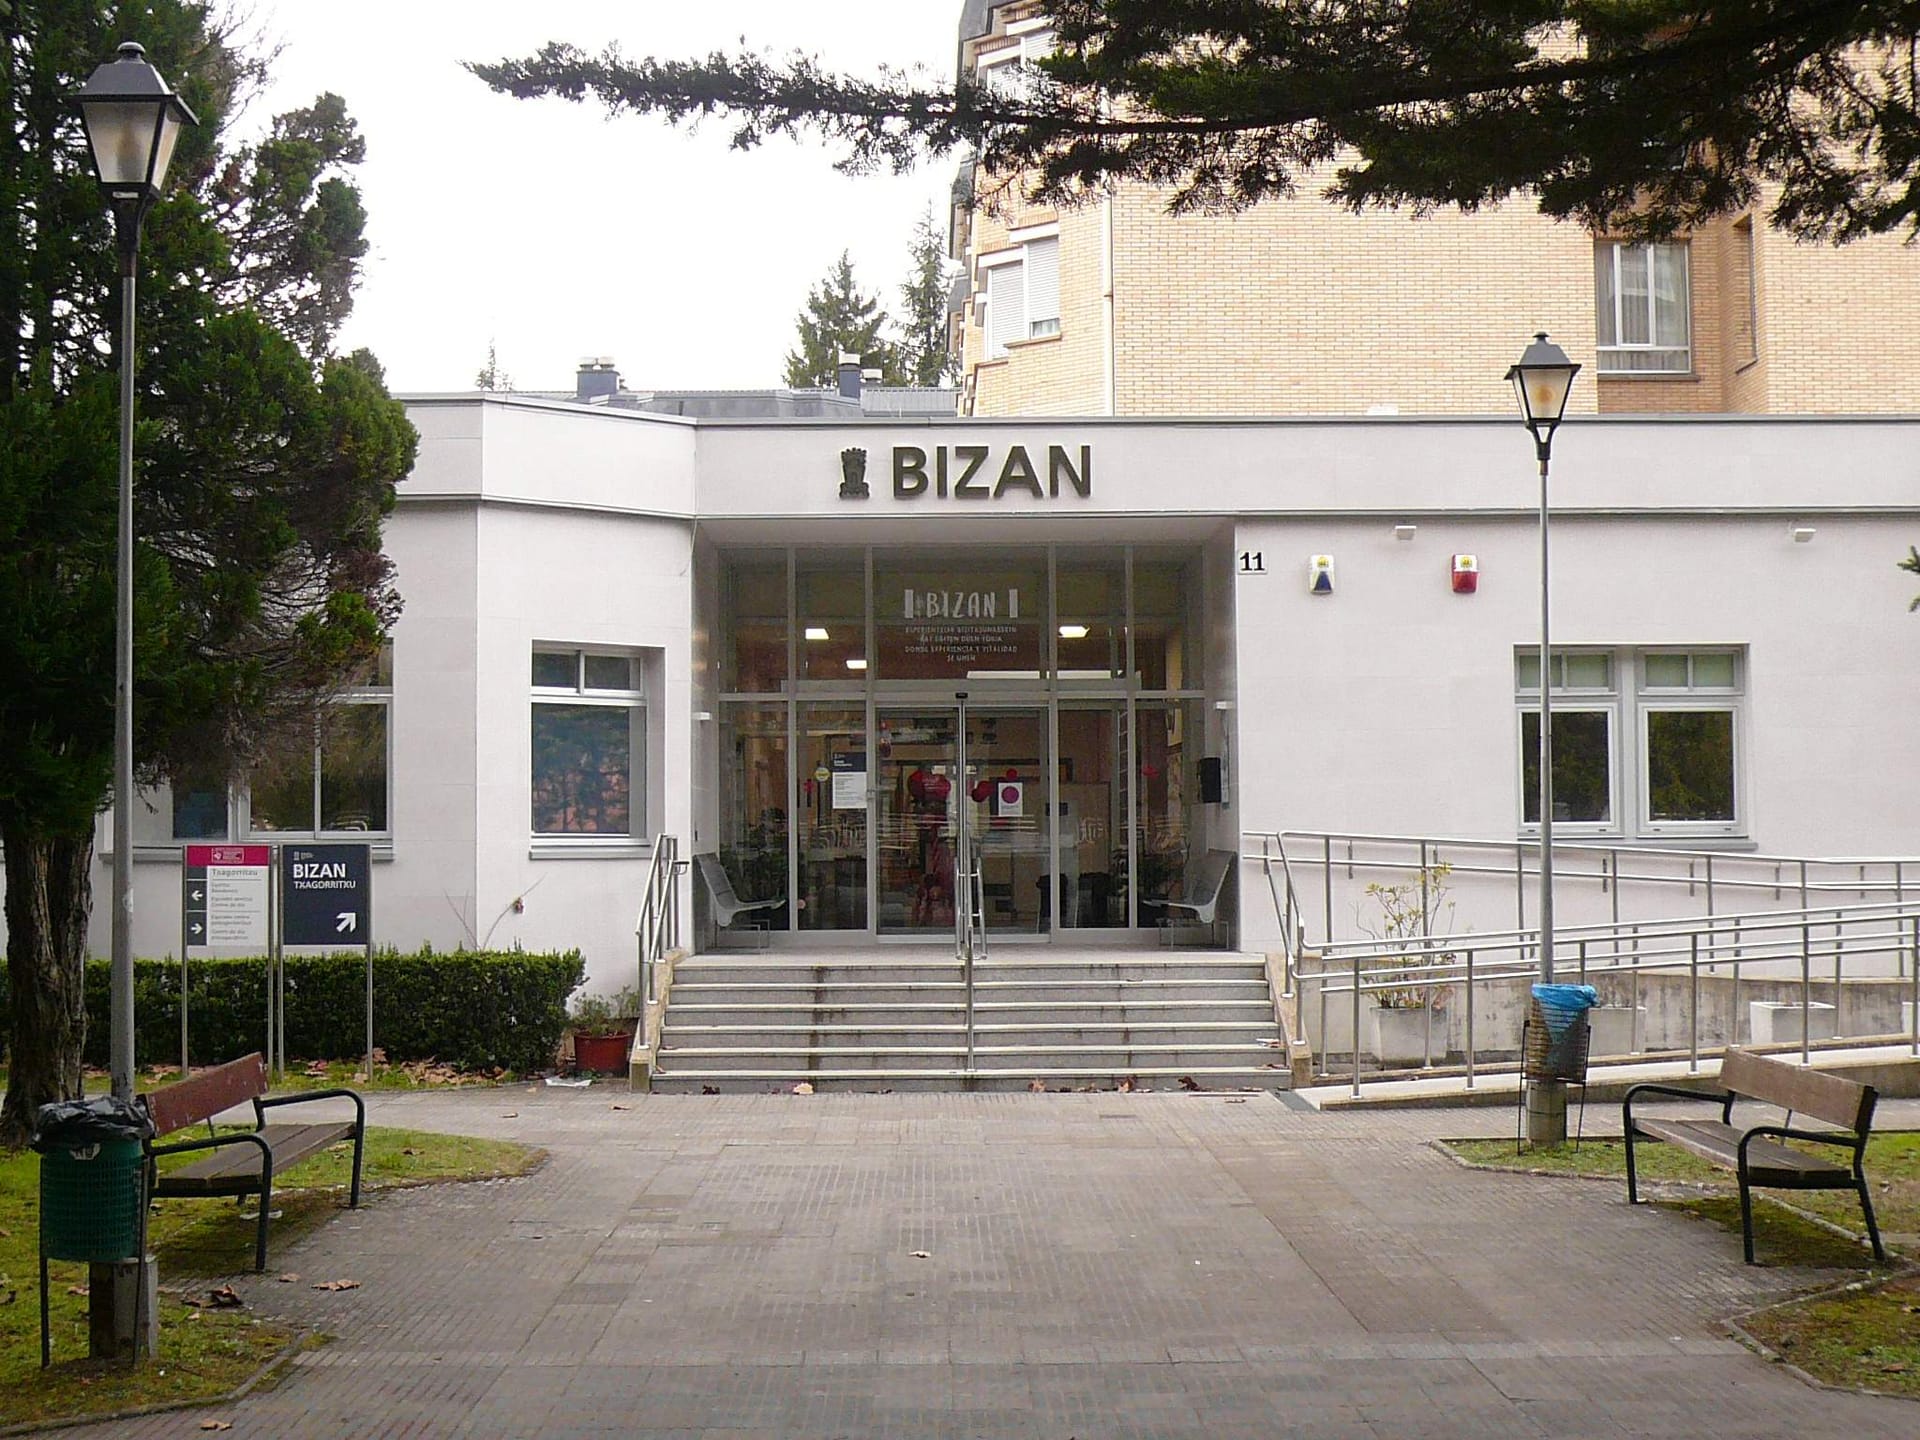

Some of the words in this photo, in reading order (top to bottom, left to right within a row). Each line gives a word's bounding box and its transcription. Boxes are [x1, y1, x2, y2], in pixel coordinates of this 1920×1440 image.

[893, 446, 1091, 498] BIZAN
[1239, 552, 1265, 571] 11
[926, 591, 996, 618] BIZAN
[293, 863, 346, 878] BIZAN
[294, 880, 356, 889] TXAGORRITXU
